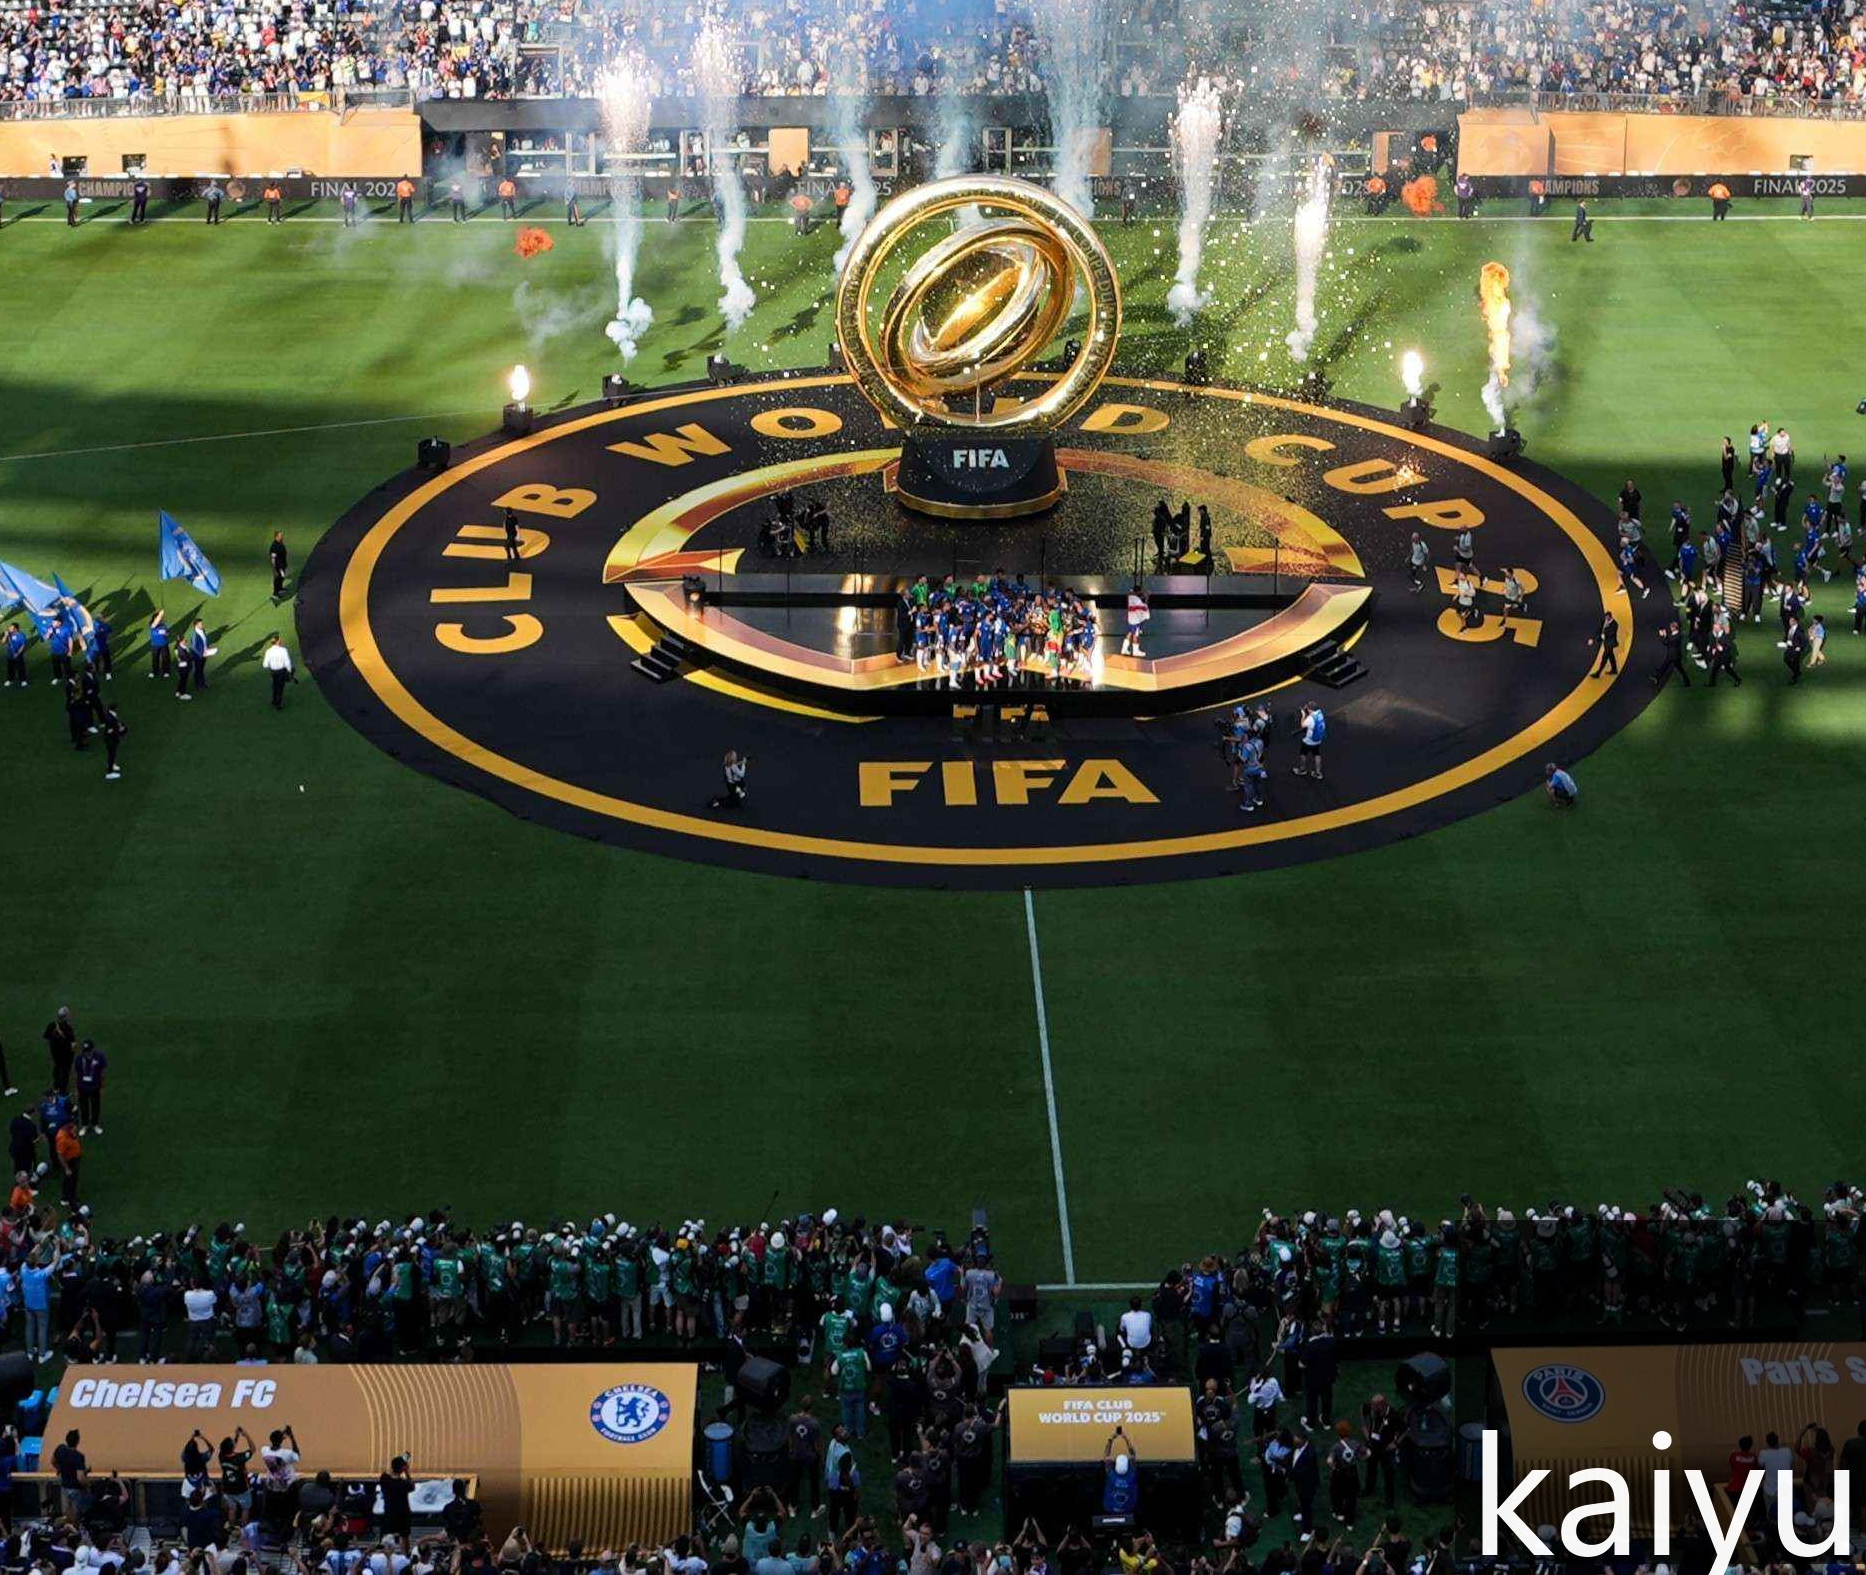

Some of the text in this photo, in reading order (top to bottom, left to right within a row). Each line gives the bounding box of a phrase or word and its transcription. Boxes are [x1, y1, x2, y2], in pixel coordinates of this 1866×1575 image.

[366, 181, 401, 196] 202
[1528, 180, 1600, 196] AMPIONS
[952, 448, 1010, 469] FIFA
[429, 403, 1544, 655] CLUB WOD CUP 25
[859, 759, 1161, 806] FIFA
[1532, 1366, 1584, 1382] PARIS
[1740, 1357, 1840, 1385] Paris
[69, 1379, 278, 1409] Chelsea FC
[603, 1383, 660, 1399] CHELSEA
[1063, 1400, 1133, 1411] FIFA CLUB
[1039, 1411, 1091, 1423] WORLD
[1094, 1411, 1123, 1423] CUP
